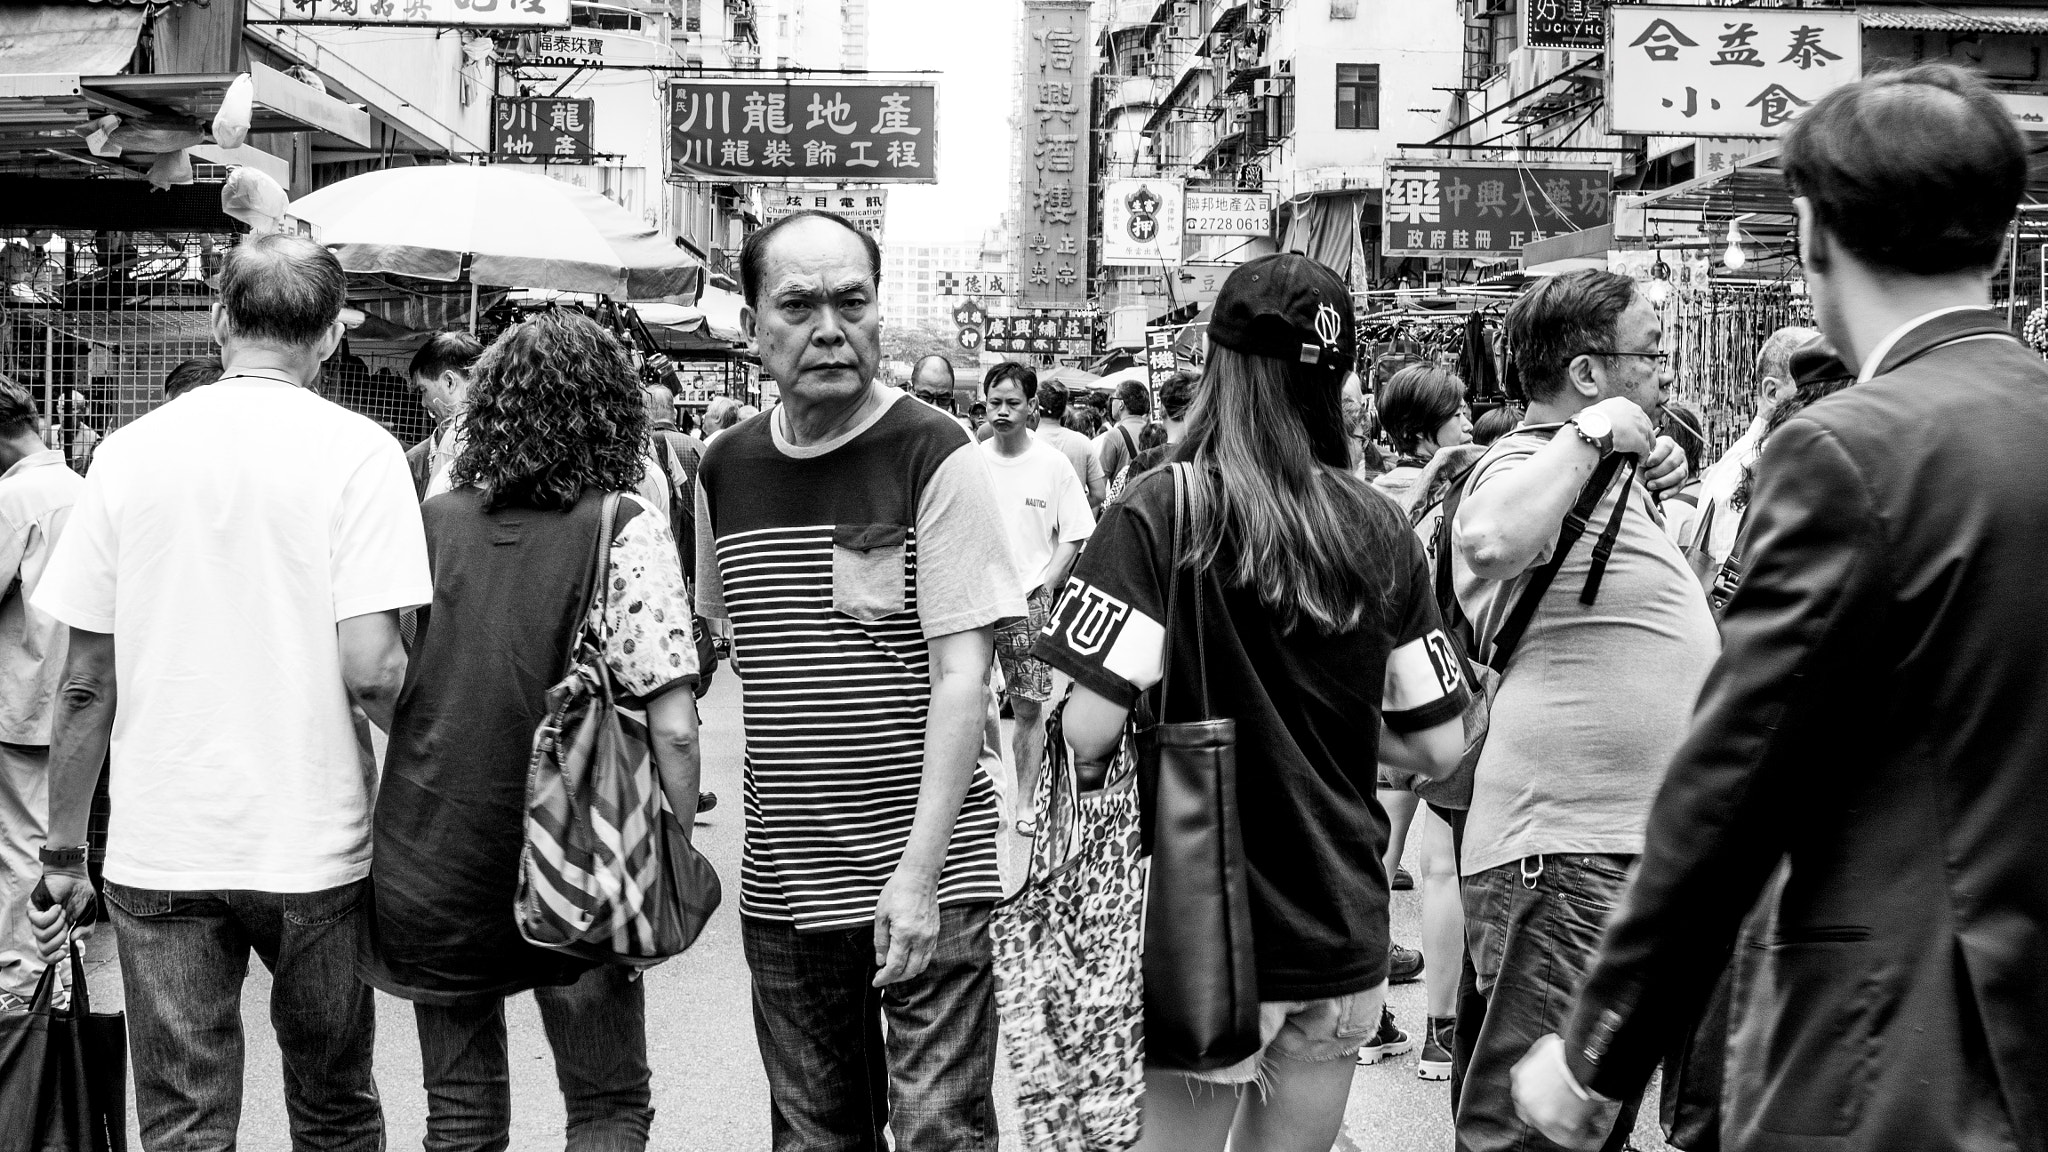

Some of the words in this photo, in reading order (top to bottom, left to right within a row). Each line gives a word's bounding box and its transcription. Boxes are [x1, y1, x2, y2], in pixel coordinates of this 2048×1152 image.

[1535, 23, 1580, 34] LUCKY
[1628, 18, 1844, 69] 合益泰
[502, 102, 584, 132] 川龍
[678, 91, 922, 135] 川龍地產
[1661, 83, 1812, 127] 小食
[1032, 27, 1081, 225] 信興酒樓
[502, 133, 583, 165] 地產
[678, 138, 921, 168] 川龍裝飾工程
[1187, 197, 1270, 212] 聯邦地產公司
[1390, 170, 1440, 224] 藥
[1444, 176, 1609, 219] 中興大藥坊
[1131, 216, 1154, 239] 押
[1200, 218, 1233, 230] 2728
[1236, 218, 1270, 231] 0613
[1407, 230, 1492, 250] 政府註冊
[1199, 274, 1220, 293] 豆
